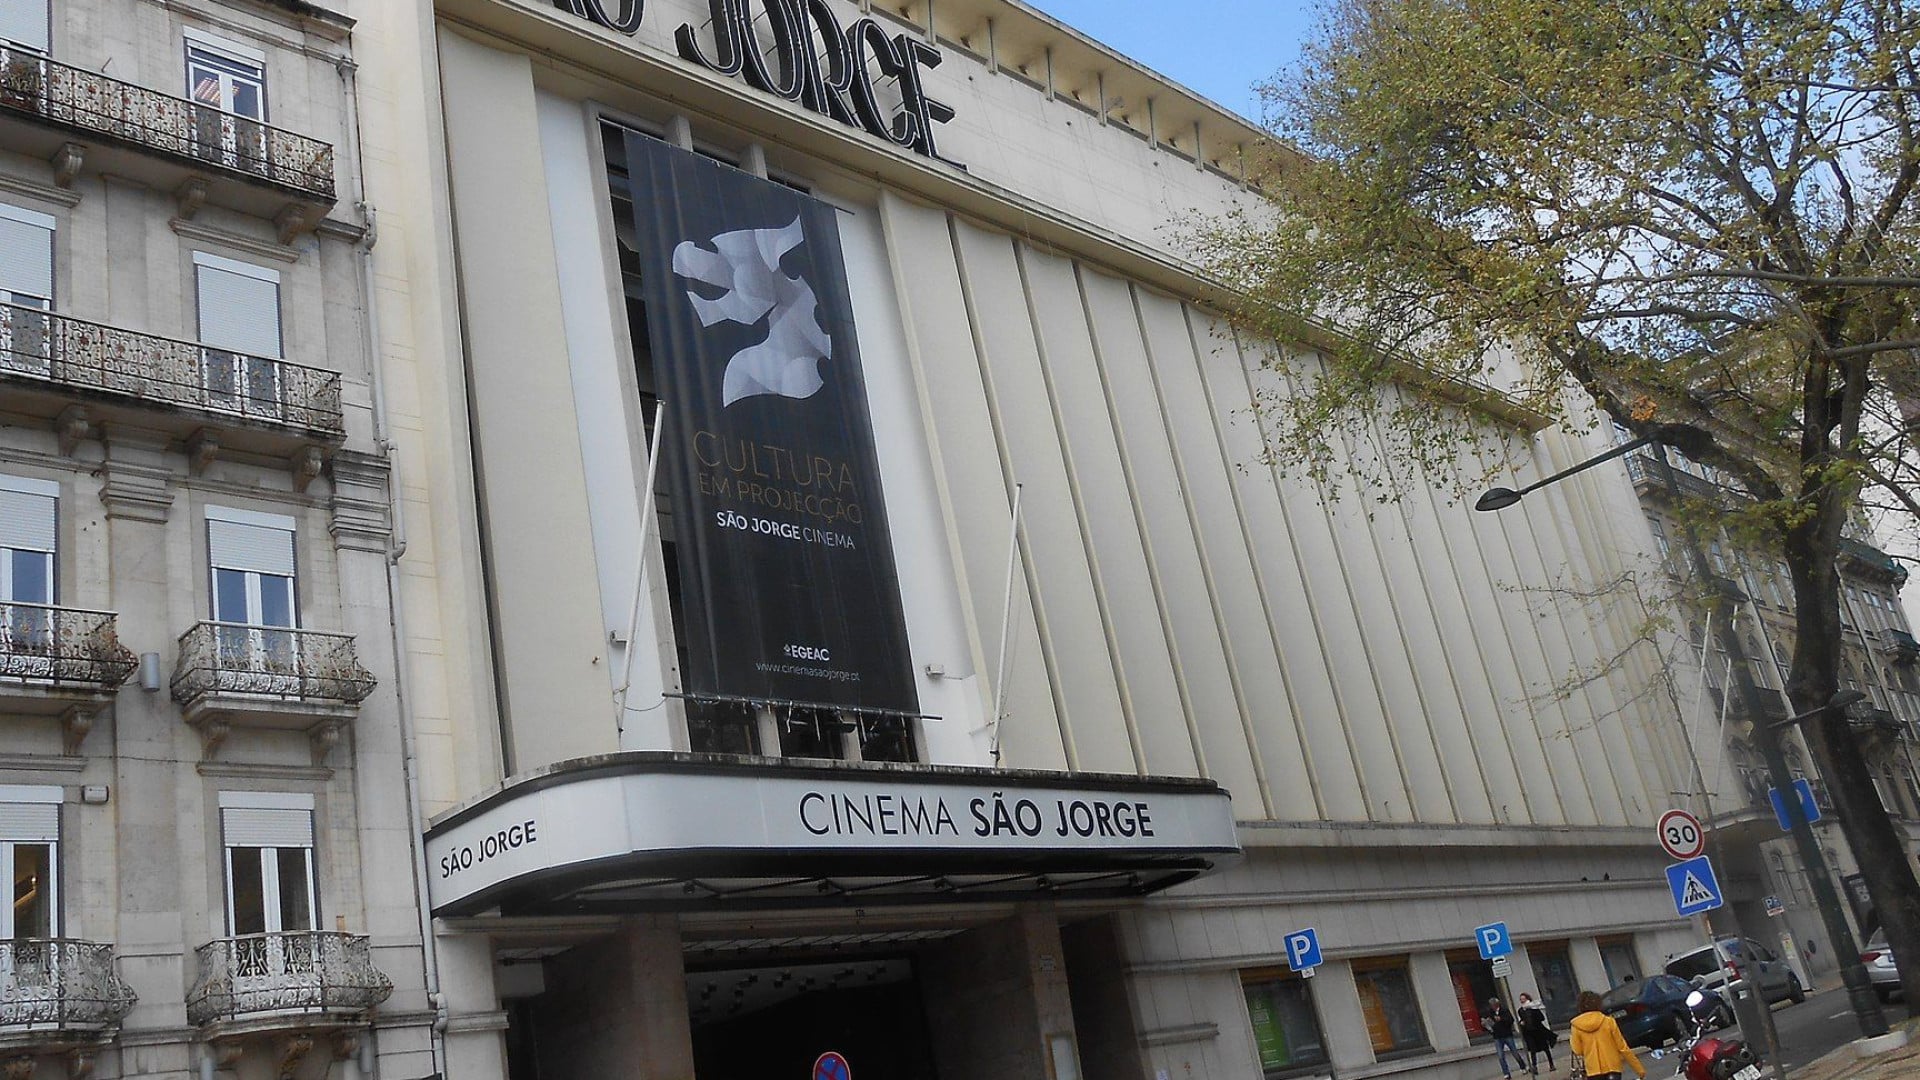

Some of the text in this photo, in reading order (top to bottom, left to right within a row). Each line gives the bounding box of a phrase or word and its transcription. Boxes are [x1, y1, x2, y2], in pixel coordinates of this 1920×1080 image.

[693, 431, 858, 498] CULTURA
[699, 472, 863, 524] EM PROJECÇÃO
[716, 509, 856, 550] SÃO JORGE CINEMA
[791, 645, 830, 661] EGEAC
[755, 662, 860, 682] www.cinemasaojorge.pt
[799, 792, 1155, 838] CINEMA SÃO JORGE
[441, 820, 537, 878] SÃO JORGE
[1667, 825, 1696, 845] 30
[1290, 934, 1311, 966] P
[1482, 928, 1501, 954] P
